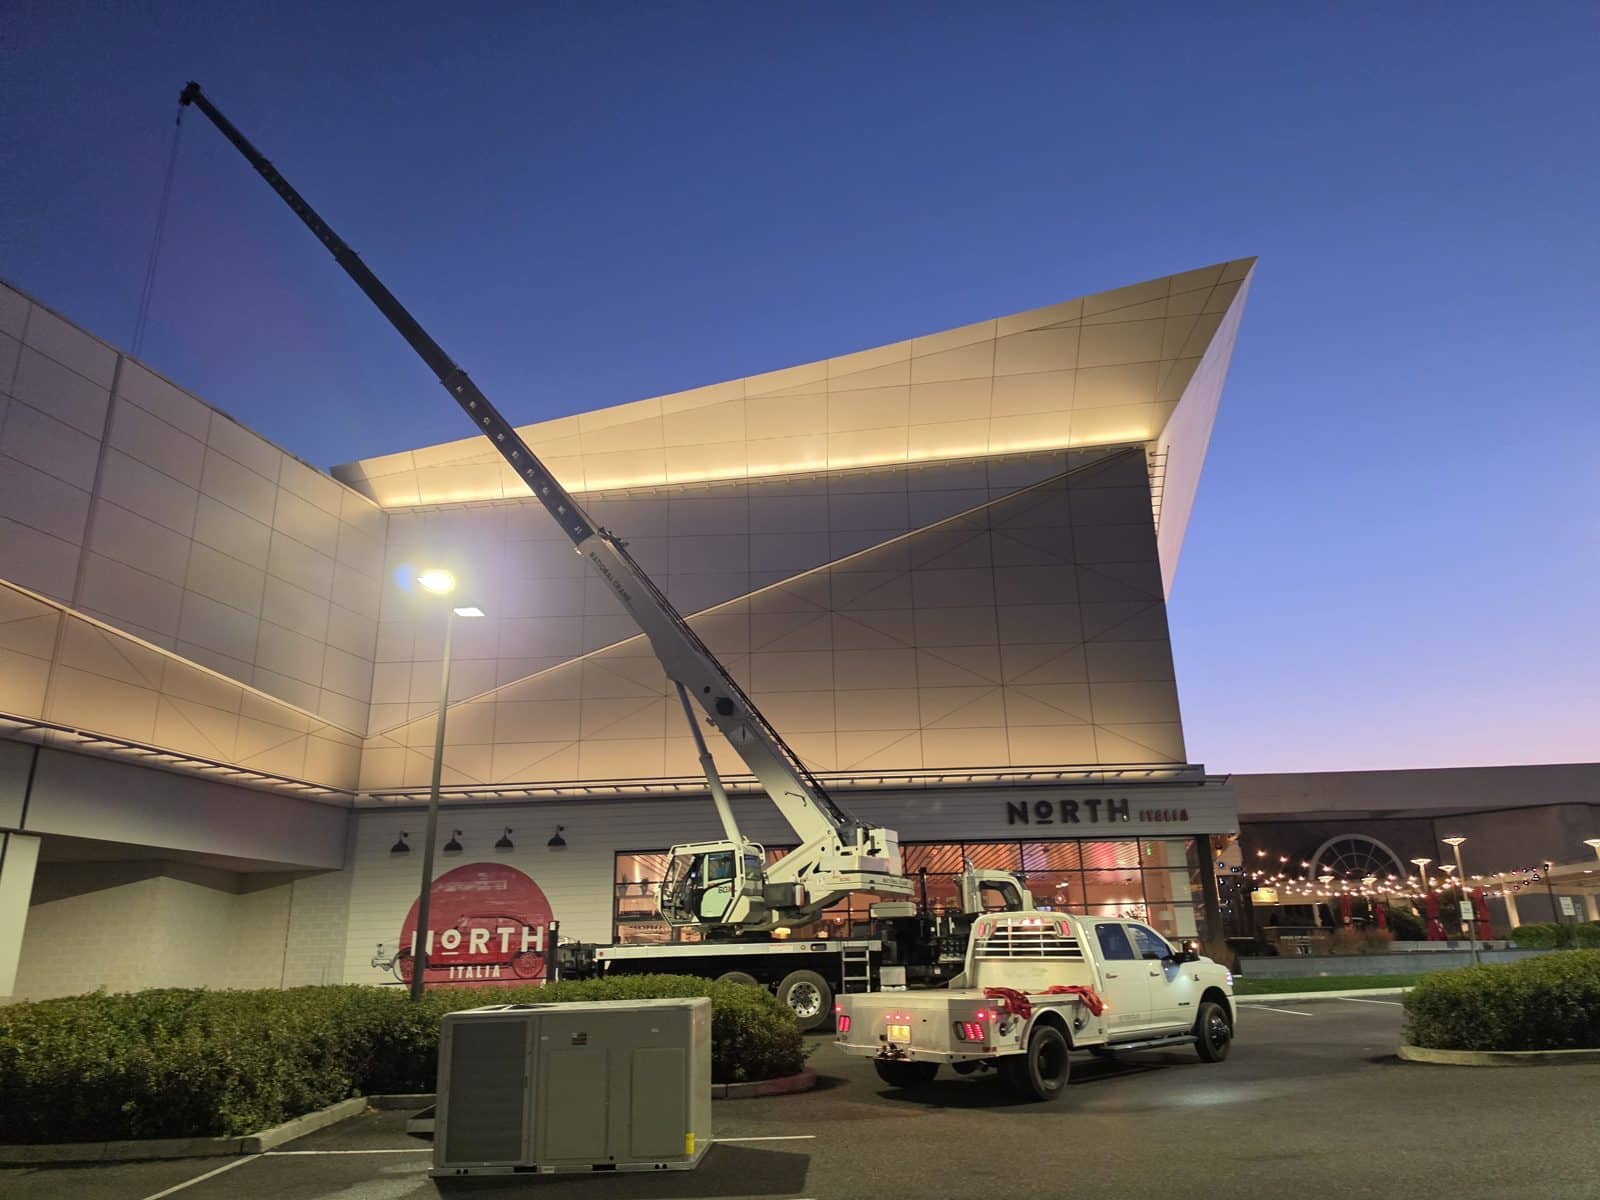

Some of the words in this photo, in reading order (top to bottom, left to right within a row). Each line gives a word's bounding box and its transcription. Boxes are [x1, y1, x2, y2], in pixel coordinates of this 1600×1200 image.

[1007, 799, 1130, 825] NORTH
[1139, 808, 1189, 822] ITALIA
[449, 965, 500, 979] ITALIA
